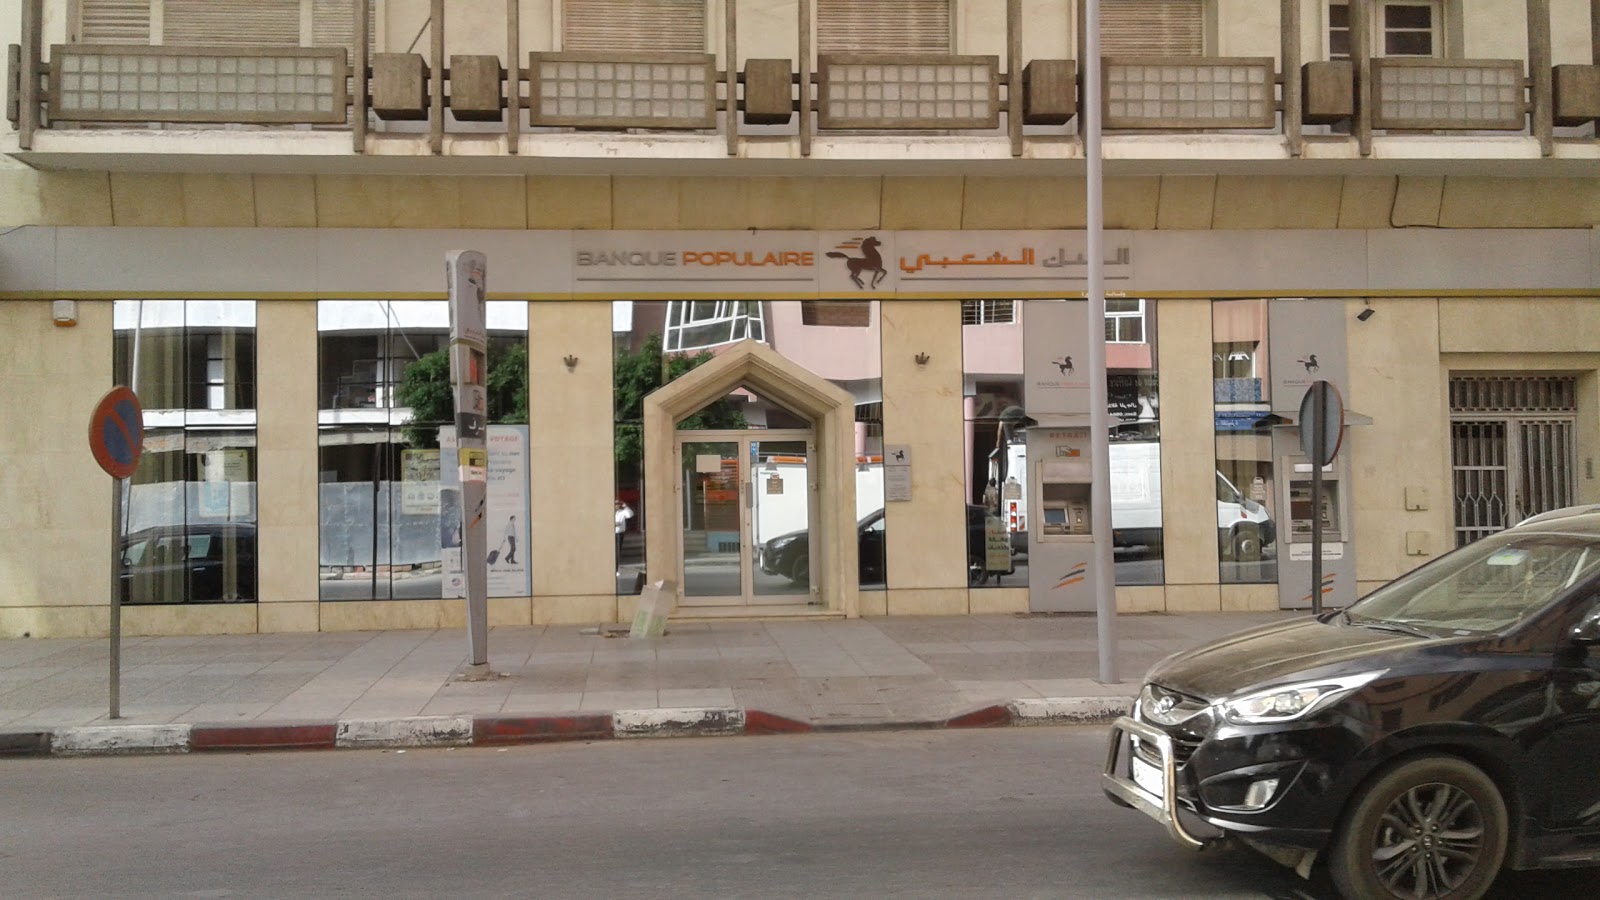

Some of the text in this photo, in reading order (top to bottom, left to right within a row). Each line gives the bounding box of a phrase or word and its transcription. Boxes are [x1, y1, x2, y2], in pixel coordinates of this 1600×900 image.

[577, 251, 814, 266] BANQUE POPULAIRE
[900, 247, 1035, 273] الشعبي
